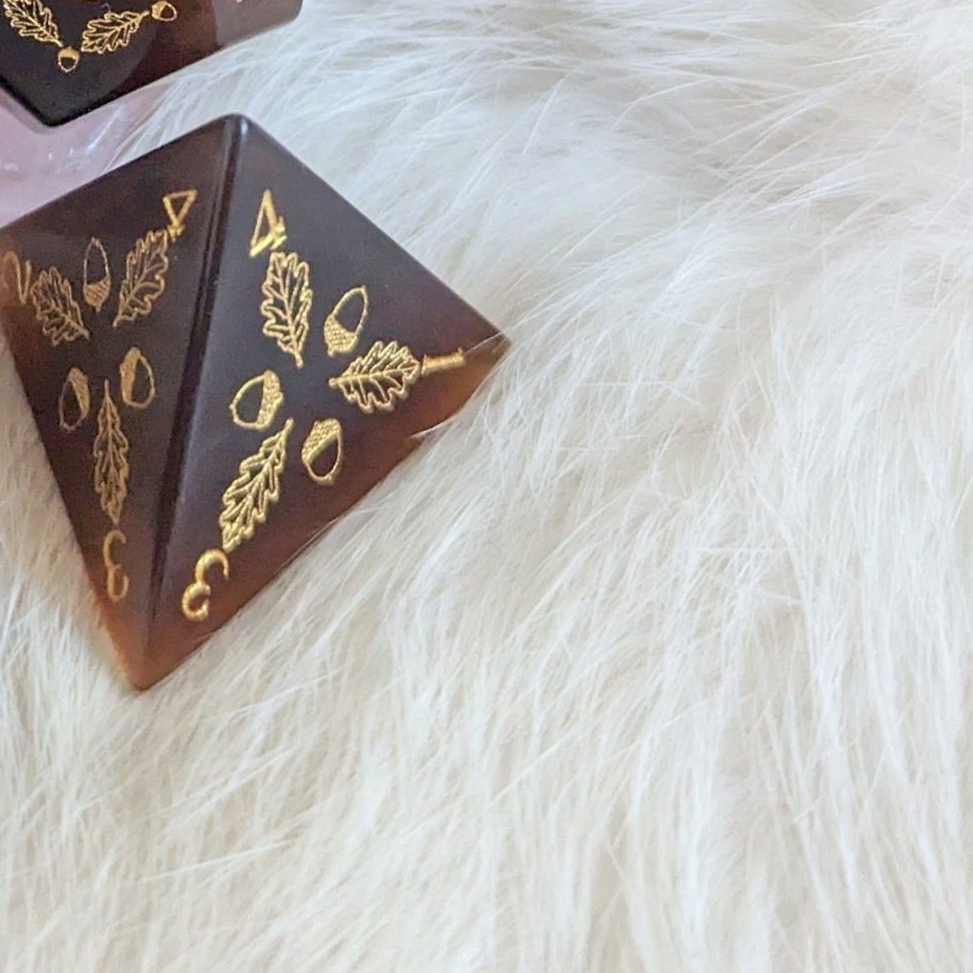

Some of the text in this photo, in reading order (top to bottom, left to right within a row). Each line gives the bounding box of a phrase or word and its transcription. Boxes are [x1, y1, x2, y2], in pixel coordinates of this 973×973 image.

[162, 189, 198, 242] 4
[250, 189, 287, 257] 4
[3, 249, 32, 305] 2
[103, 529, 128, 602] 3
[181, 549, 229, 621] 3
